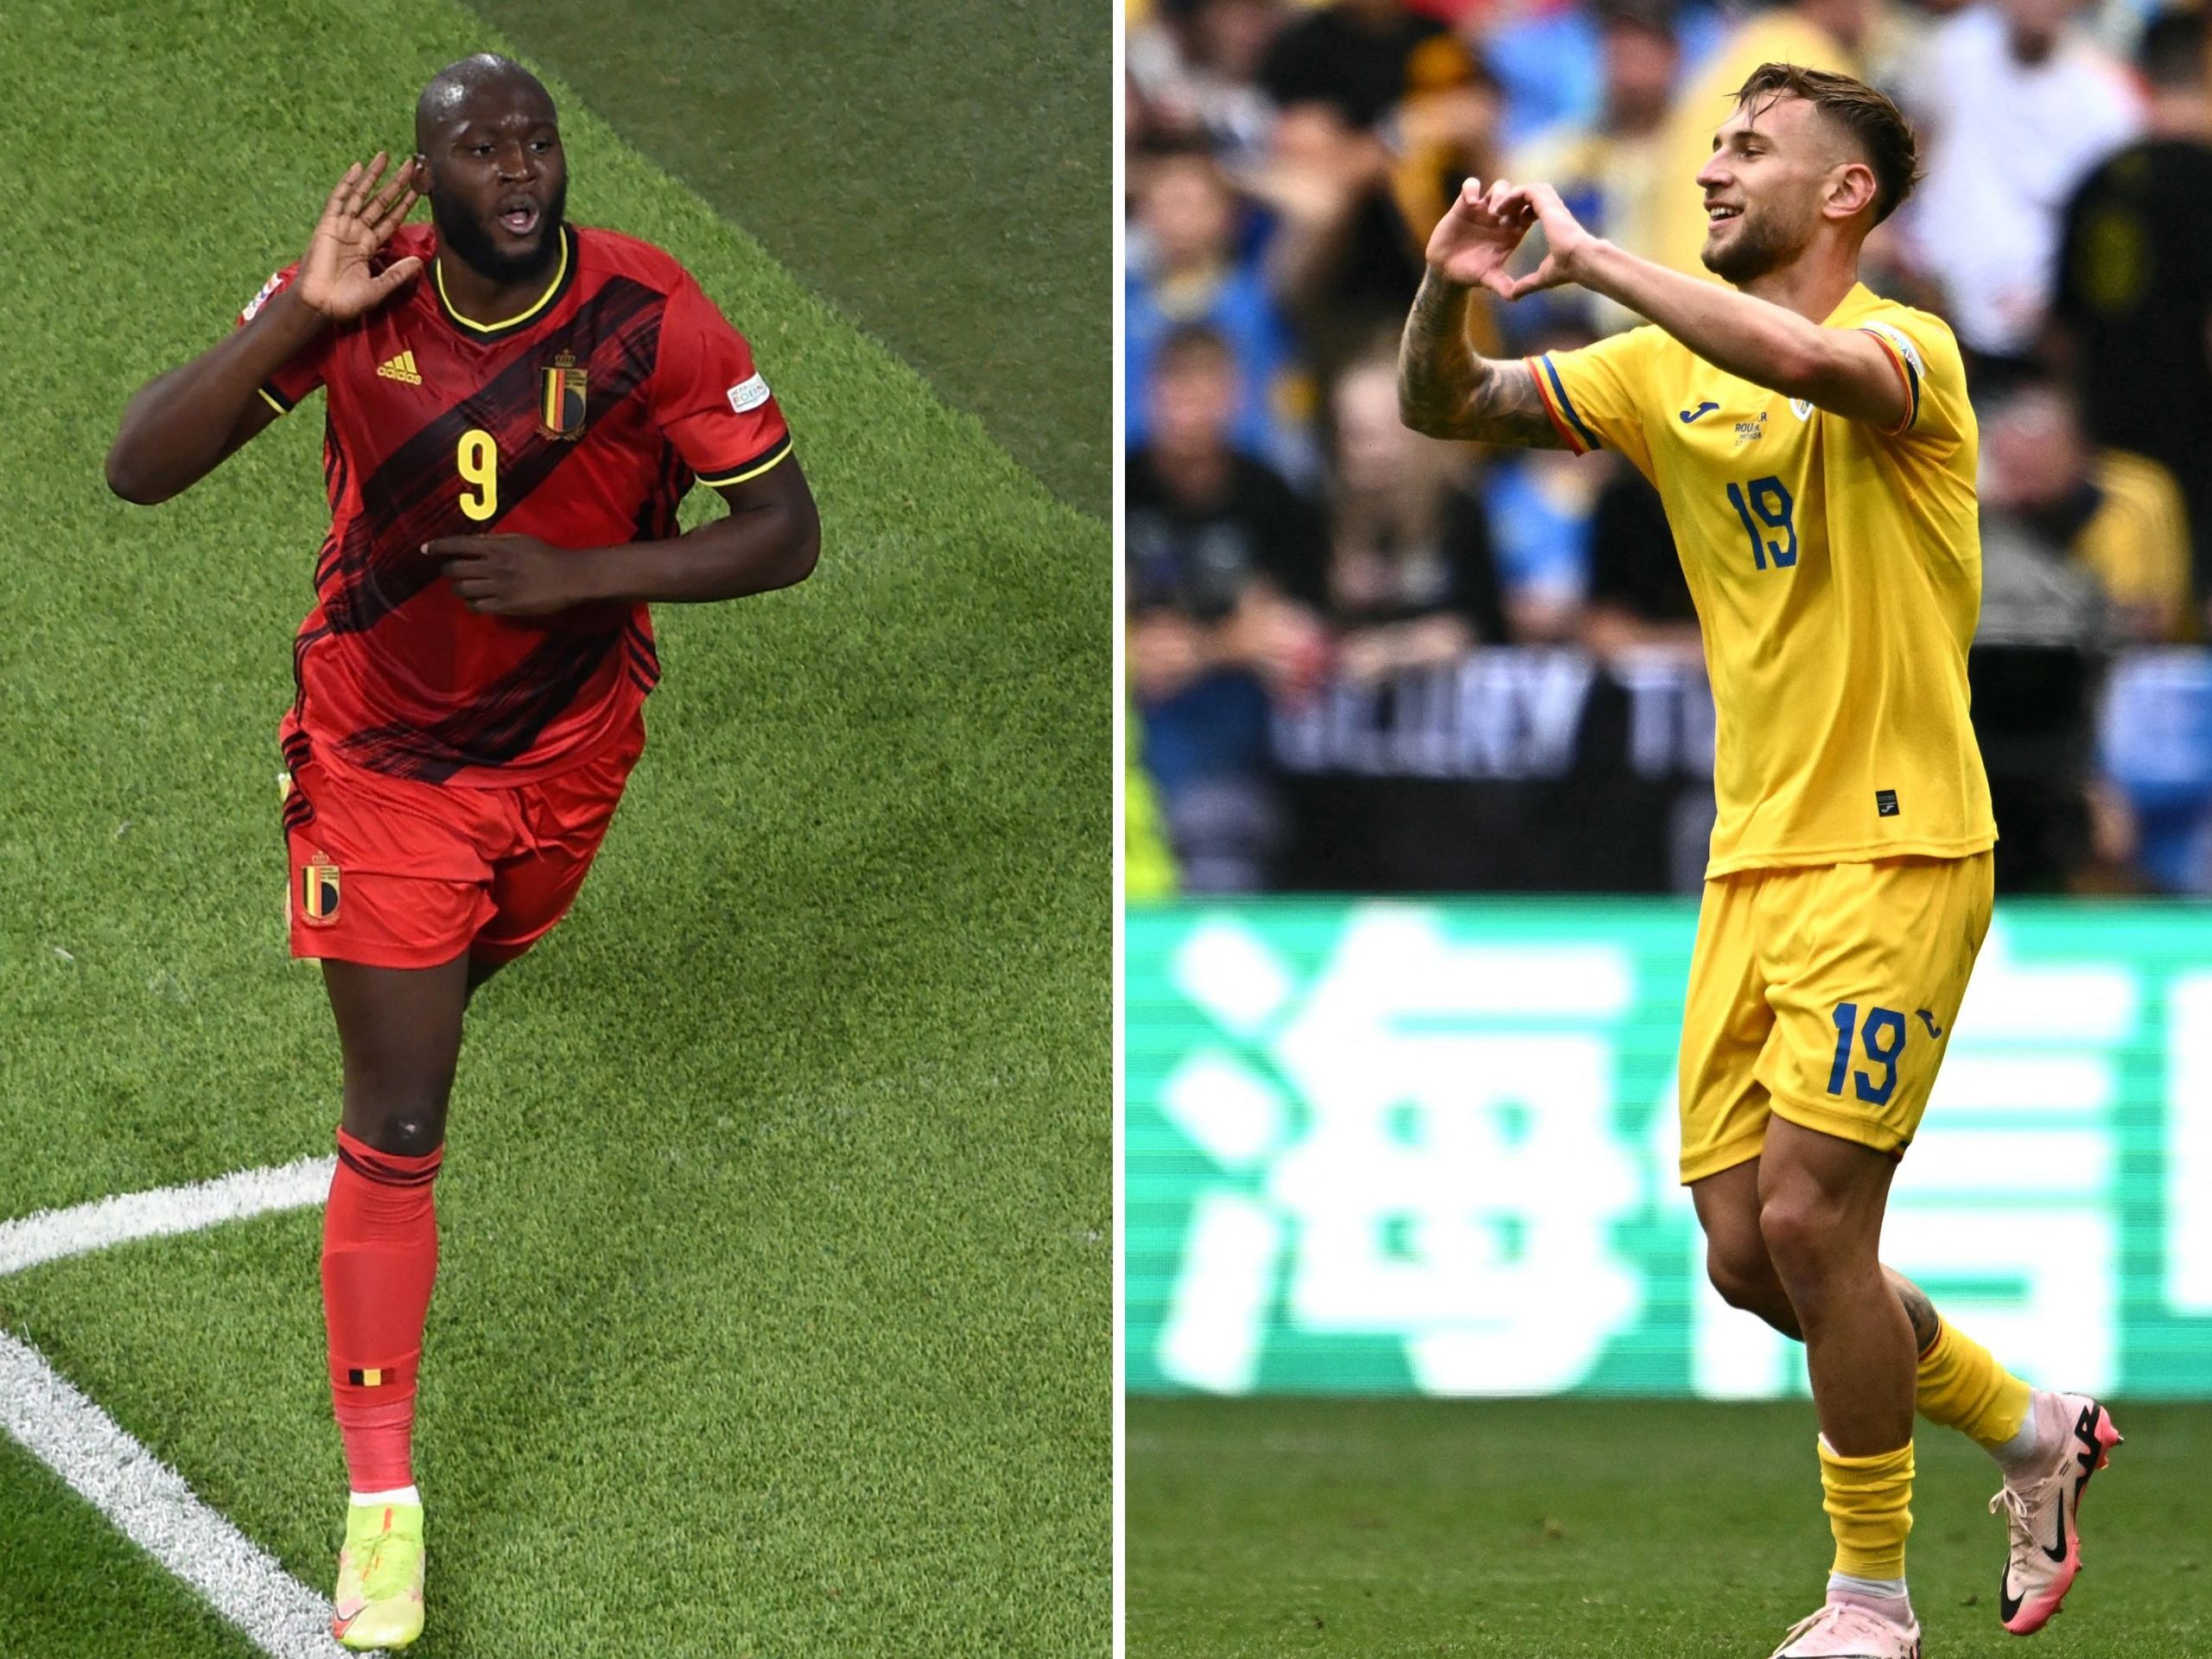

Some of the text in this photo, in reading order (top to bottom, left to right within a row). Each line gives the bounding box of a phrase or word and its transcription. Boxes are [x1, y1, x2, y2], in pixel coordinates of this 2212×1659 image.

[377, 366, 423, 385] adidas
[457, 429, 498, 521] 9
[1726, 475, 1797, 571] 19
[1827, 1002, 1907, 1107] 19
